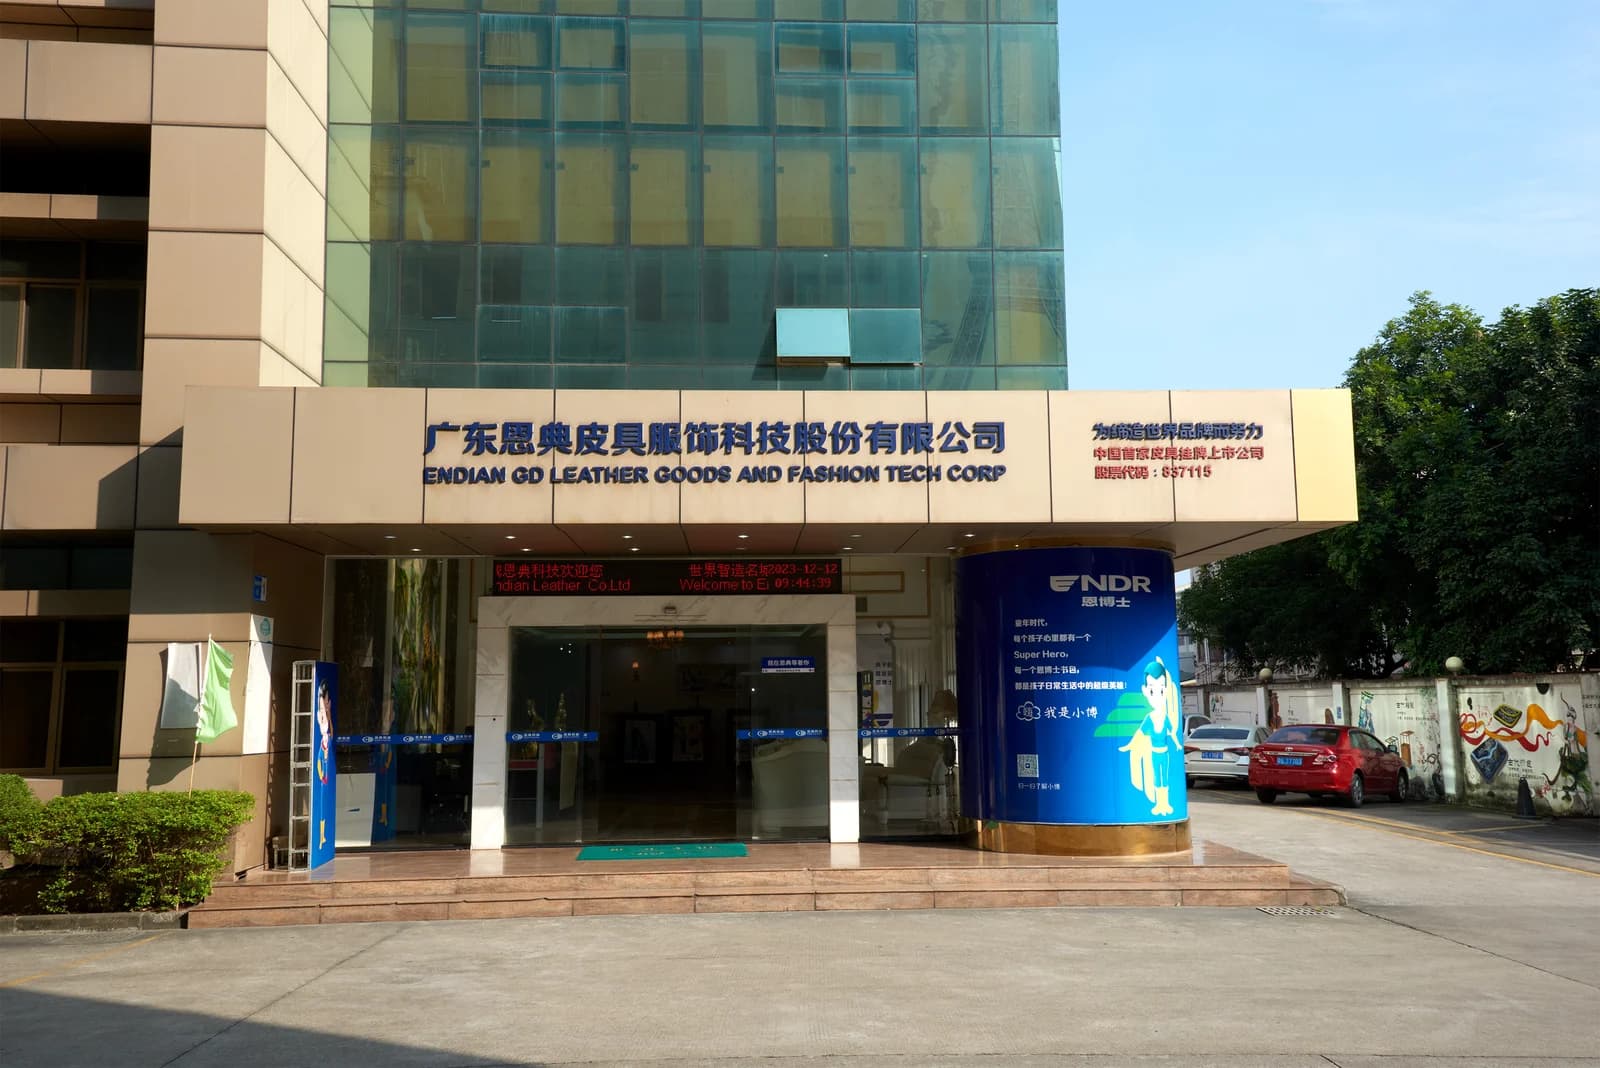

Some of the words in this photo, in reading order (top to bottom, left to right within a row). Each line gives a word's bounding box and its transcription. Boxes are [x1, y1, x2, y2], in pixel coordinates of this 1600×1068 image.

[1092, 422, 1264, 441] 为缔造世界品牌而努力
[424, 421, 1006, 456] 广东恩典皮具服饰科技股份有限公司
[1093, 445, 1265, 461] 中国首家皮具挂牌上市公司
[422, 466, 505, 485] ENDIAN
[511, 467, 544, 484] GD
[550, 466, 649, 484] LEATHER
[654, 466, 731, 483] GOODS
[736, 466, 782, 483] AND
[787, 465, 880, 483] FASHION
[885, 465, 942, 482] TECH
[946, 464, 1006, 482] CORP
[533, 579, 581, 592] Leather
[680, 579, 738, 591] Welcome
[742, 579, 754, 591] to
[1081, 596, 1131, 608] 恩博士
[1014, 651, 1040, 660] Super
[1044, 706, 1098, 719] 我是小博
